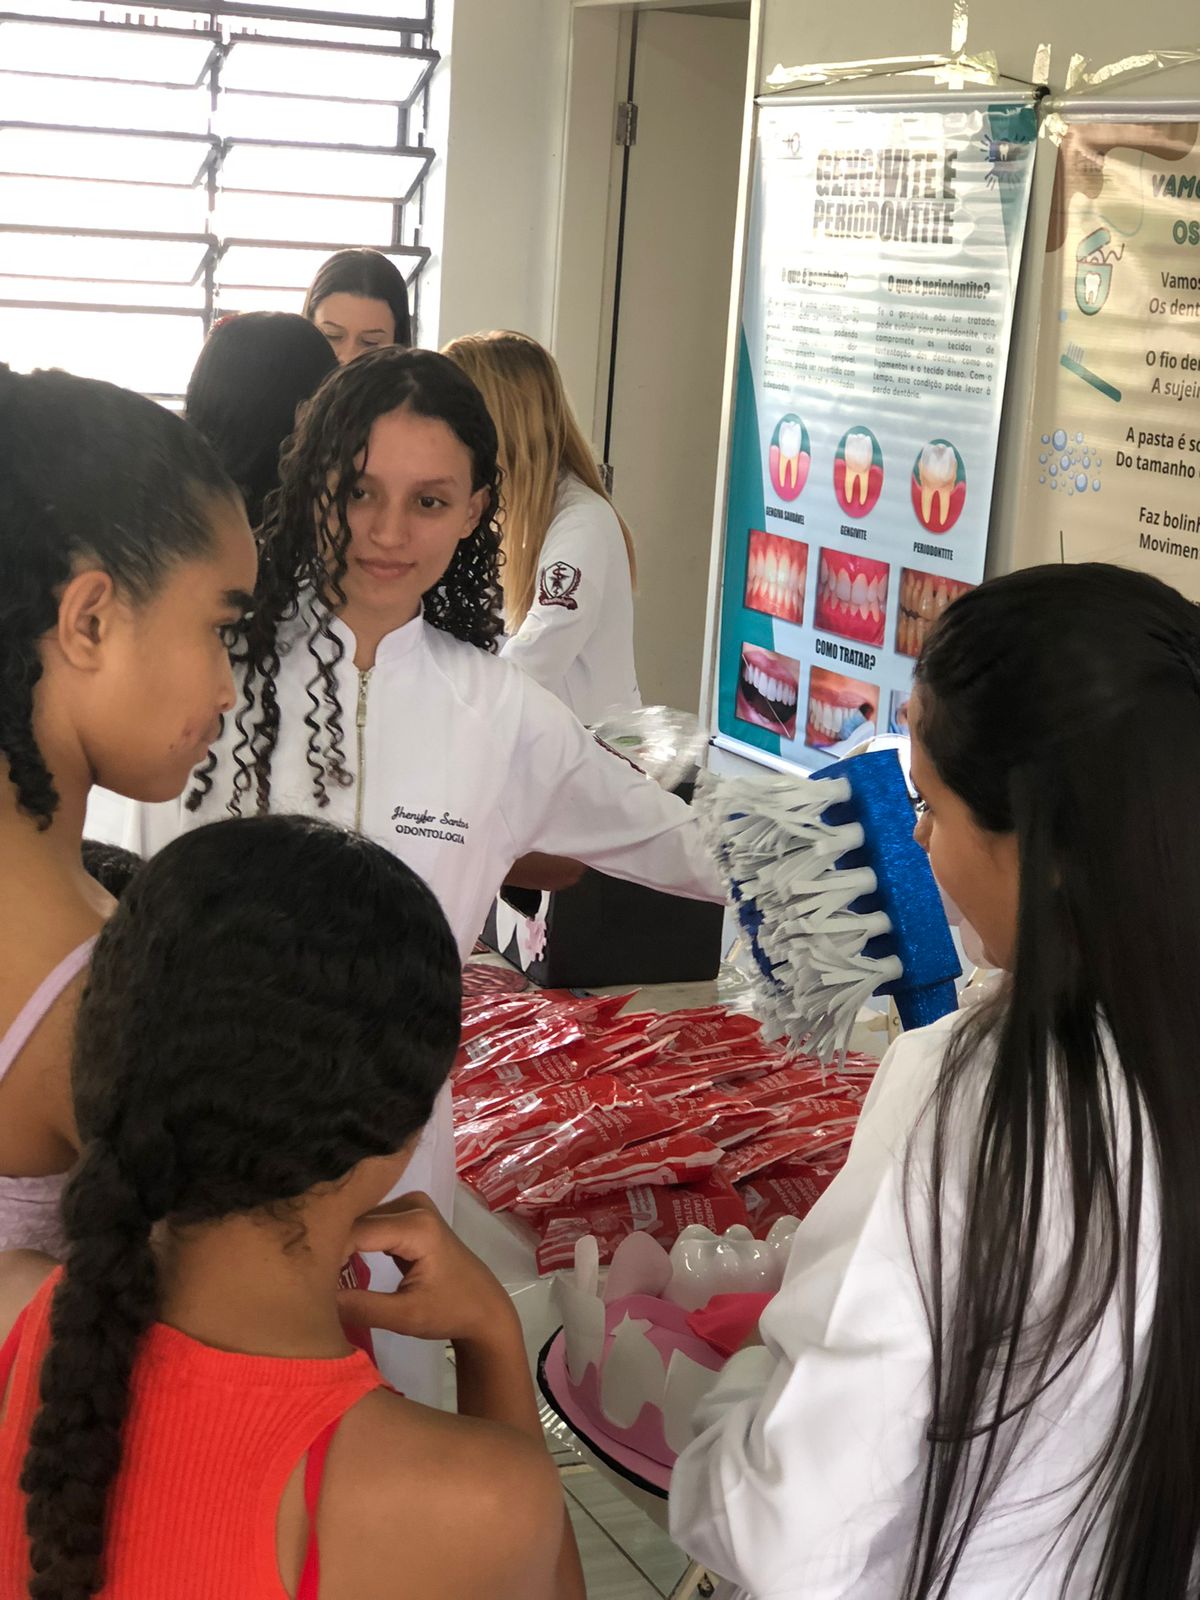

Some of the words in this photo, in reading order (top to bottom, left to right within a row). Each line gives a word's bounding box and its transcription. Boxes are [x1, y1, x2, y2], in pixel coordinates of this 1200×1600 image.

[1173, 220, 1200, 245] OS
[896, 278, 914, 294] que
[915, 277, 921, 293] é
[922, 279, 991, 299] periodontite?
[1149, 298, 1166, 314] Os
[948, 341, 972, 352] tecidos
[986, 345, 995, 354] de
[1146, 350, 1156, 366] O
[1160, 351, 1177, 369] fio
[924, 366, 944, 376] tecido
[970, 370, 985, 380] Com
[945, 382, 962, 392] pode
[1151, 377, 1161, 394] A
[1125, 427, 1135, 443] A
[1138, 431, 1174, 449] pasta
[1178, 433, 1186, 450] é
[1116, 451, 1133, 468] Do
[1137, 455, 1195, 478] tamanho
[1139, 506, 1161, 526] Faz
[913, 542, 954, 560] PERIODONTITE
[816, 638, 838, 660] COMO
[839, 645, 877, 671] TRATAR?
[395, 824, 465, 844] ODONTOLOGIA
[683, 1199, 692, 1226] FUTU
